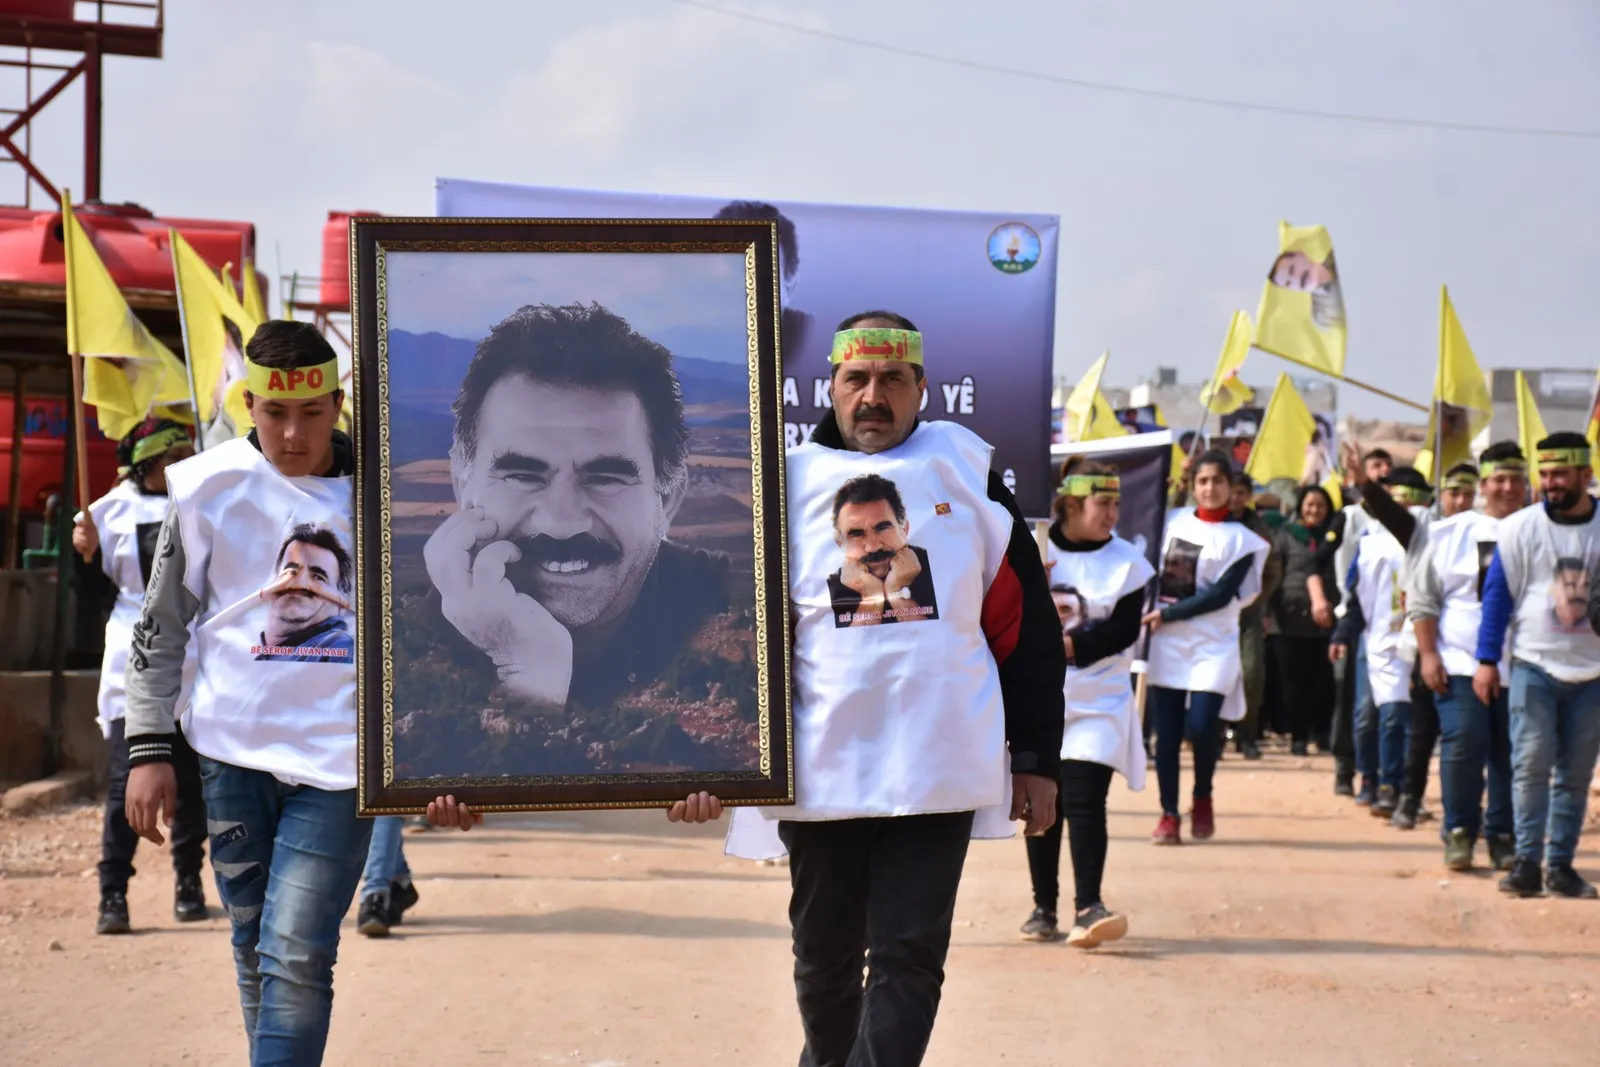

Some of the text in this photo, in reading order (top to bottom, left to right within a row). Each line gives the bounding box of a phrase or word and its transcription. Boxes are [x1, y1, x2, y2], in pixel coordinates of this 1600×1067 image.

[843, 331, 908, 361] أوجلان
[267, 367, 323, 391] APO
[941, 376, 974, 414] YÊ
[263, 646, 294, 655] SEROK
[296, 647, 321, 656] JIYAN
[323, 648, 348, 657] NABE
